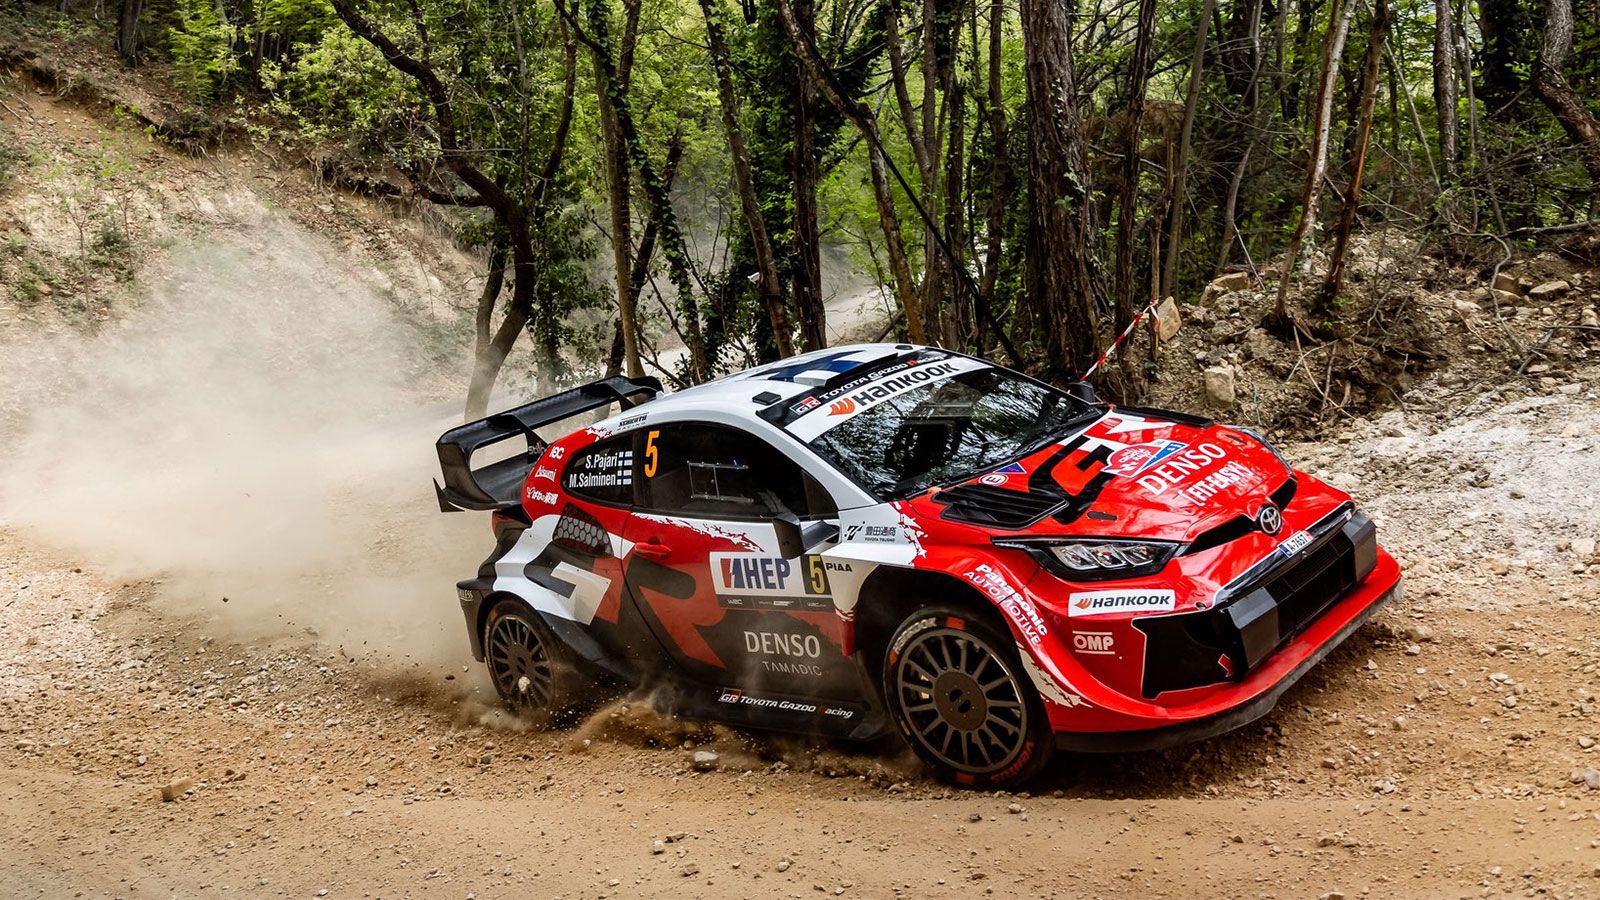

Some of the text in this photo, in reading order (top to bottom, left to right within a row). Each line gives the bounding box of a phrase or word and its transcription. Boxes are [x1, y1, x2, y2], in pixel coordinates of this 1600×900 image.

[819, 376, 869, 400] TOYOTA
[867, 363, 908, 382] GAZOO
[585, 453, 618, 471] S.Pajari
[644, 430, 660, 478] 5
[568, 471, 617, 489] M.Salminen
[1136, 441, 1226, 496] DENSO
[809, 555, 826, 594] 5
[825, 562, 853, 573] PIAA
[963, 571, 1042, 646] AUTOMOTIVE
[975, 563, 1048, 636] Panasonic
[743, 630, 821, 658] DENSO
[1073, 634, 1115, 651] OMP
[761, 660, 823, 676] TAMADIC
[718, 690, 741, 704] GR
[739, 695, 778, 708] TOYOTA
[778, 700, 817, 713] GAZOO
